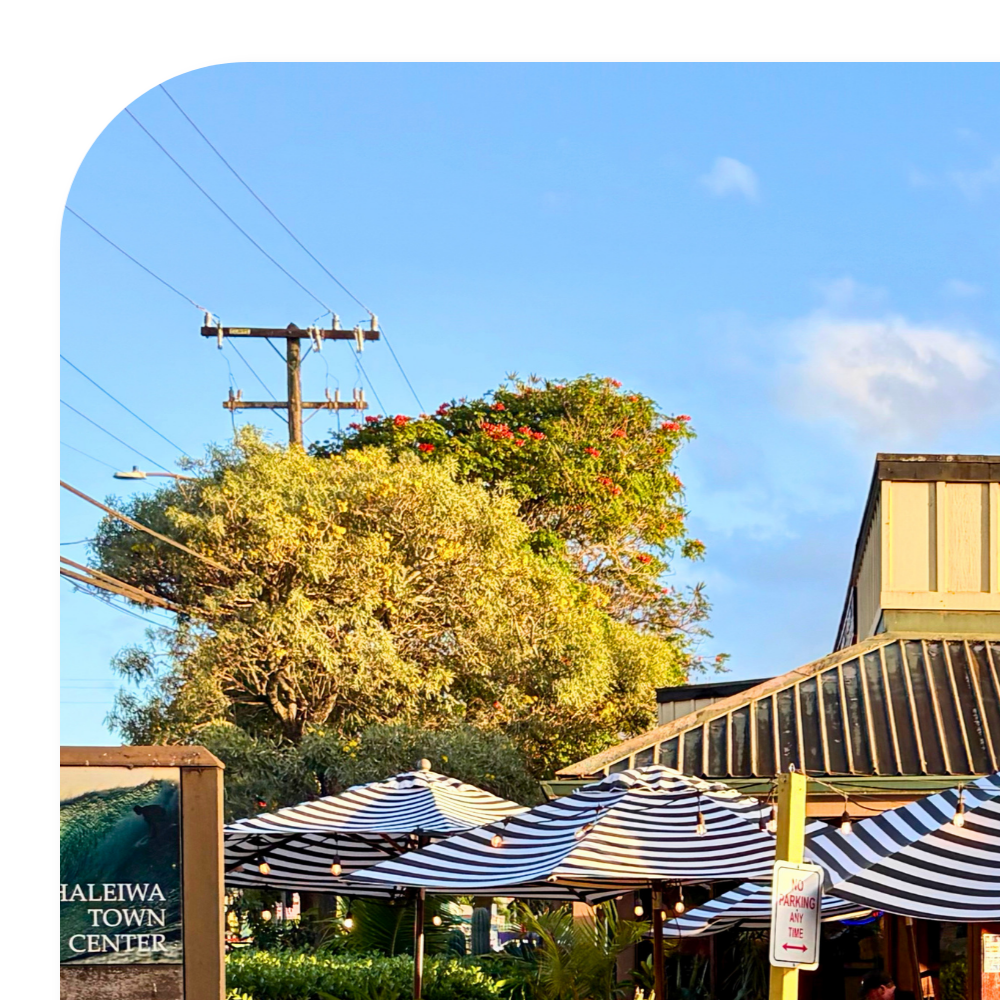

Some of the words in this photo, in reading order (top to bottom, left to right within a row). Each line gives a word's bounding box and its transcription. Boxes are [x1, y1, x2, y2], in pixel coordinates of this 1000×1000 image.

[791, 878, 804, 892] NO
[778, 893, 816, 910] PARKING
[87, 908, 166, 927] TOWN
[789, 911, 804, 923] ANY
[788, 926, 804, 939] TIME
[68, 934, 167, 952] CENTER
